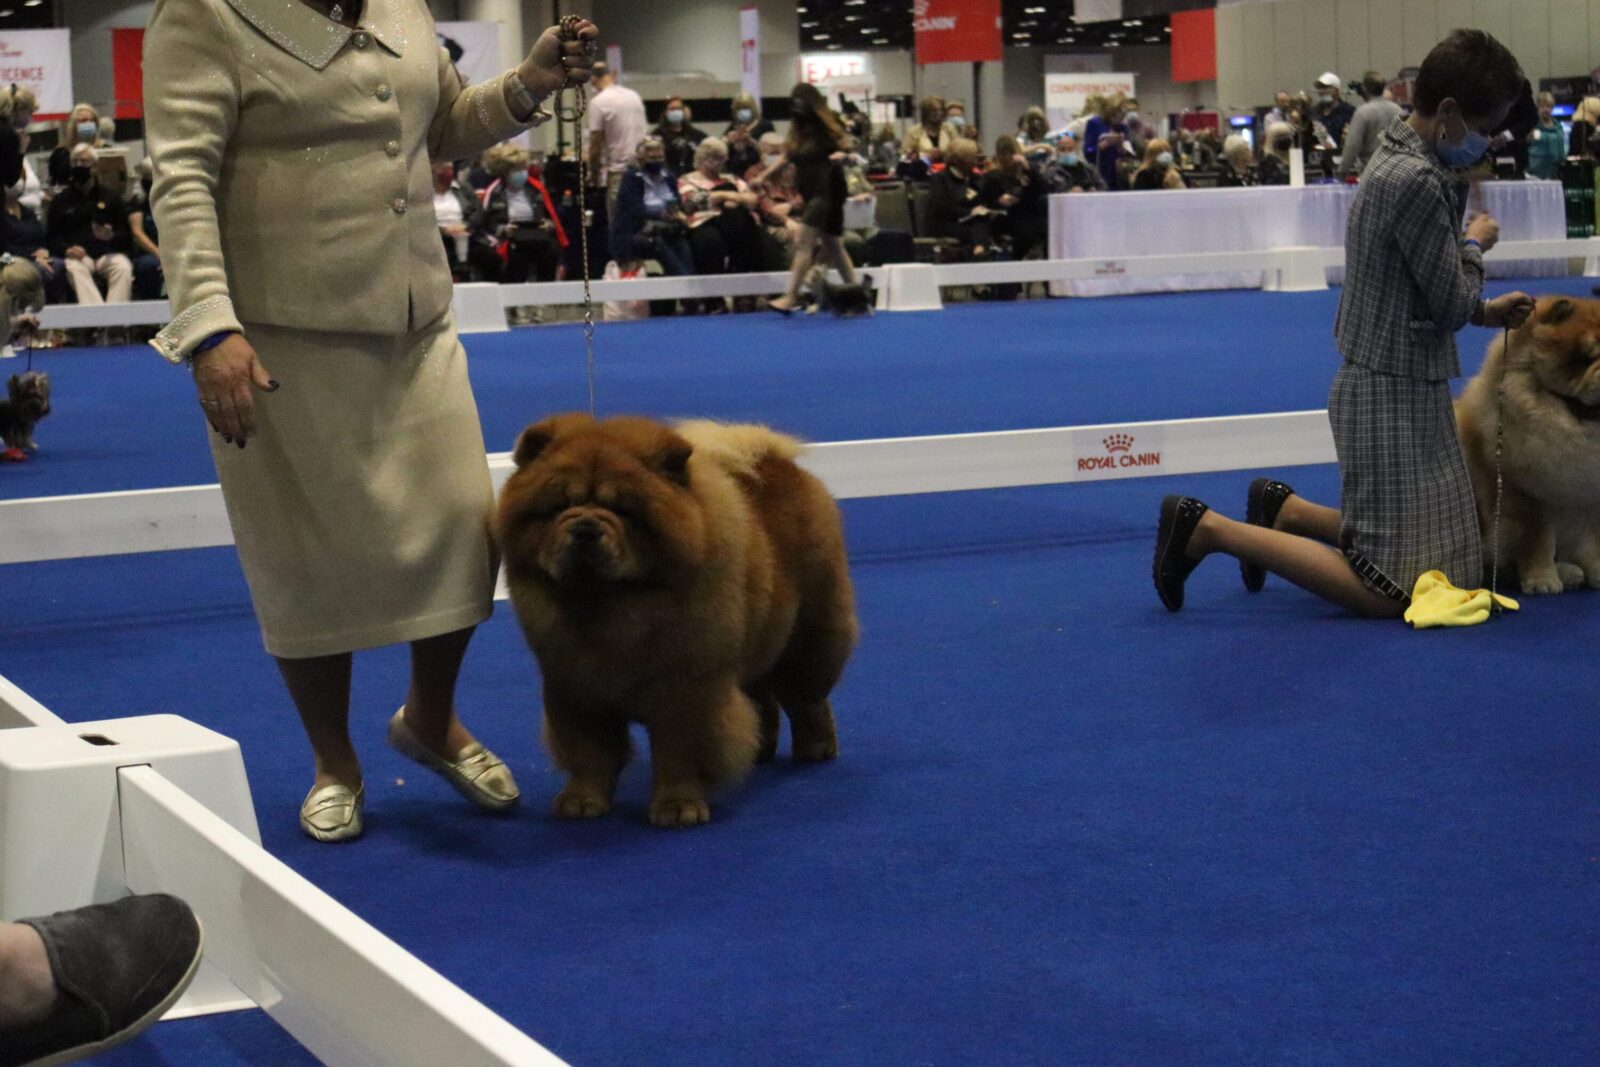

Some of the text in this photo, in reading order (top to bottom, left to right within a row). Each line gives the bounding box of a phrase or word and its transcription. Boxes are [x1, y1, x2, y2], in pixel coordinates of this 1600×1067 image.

[0, 67, 44, 81] ICENCE
[807, 61, 860, 84] EXIT
[1049, 83, 1130, 93] CONFORMATION
[1078, 453, 1160, 471] ROYAL CANIN
